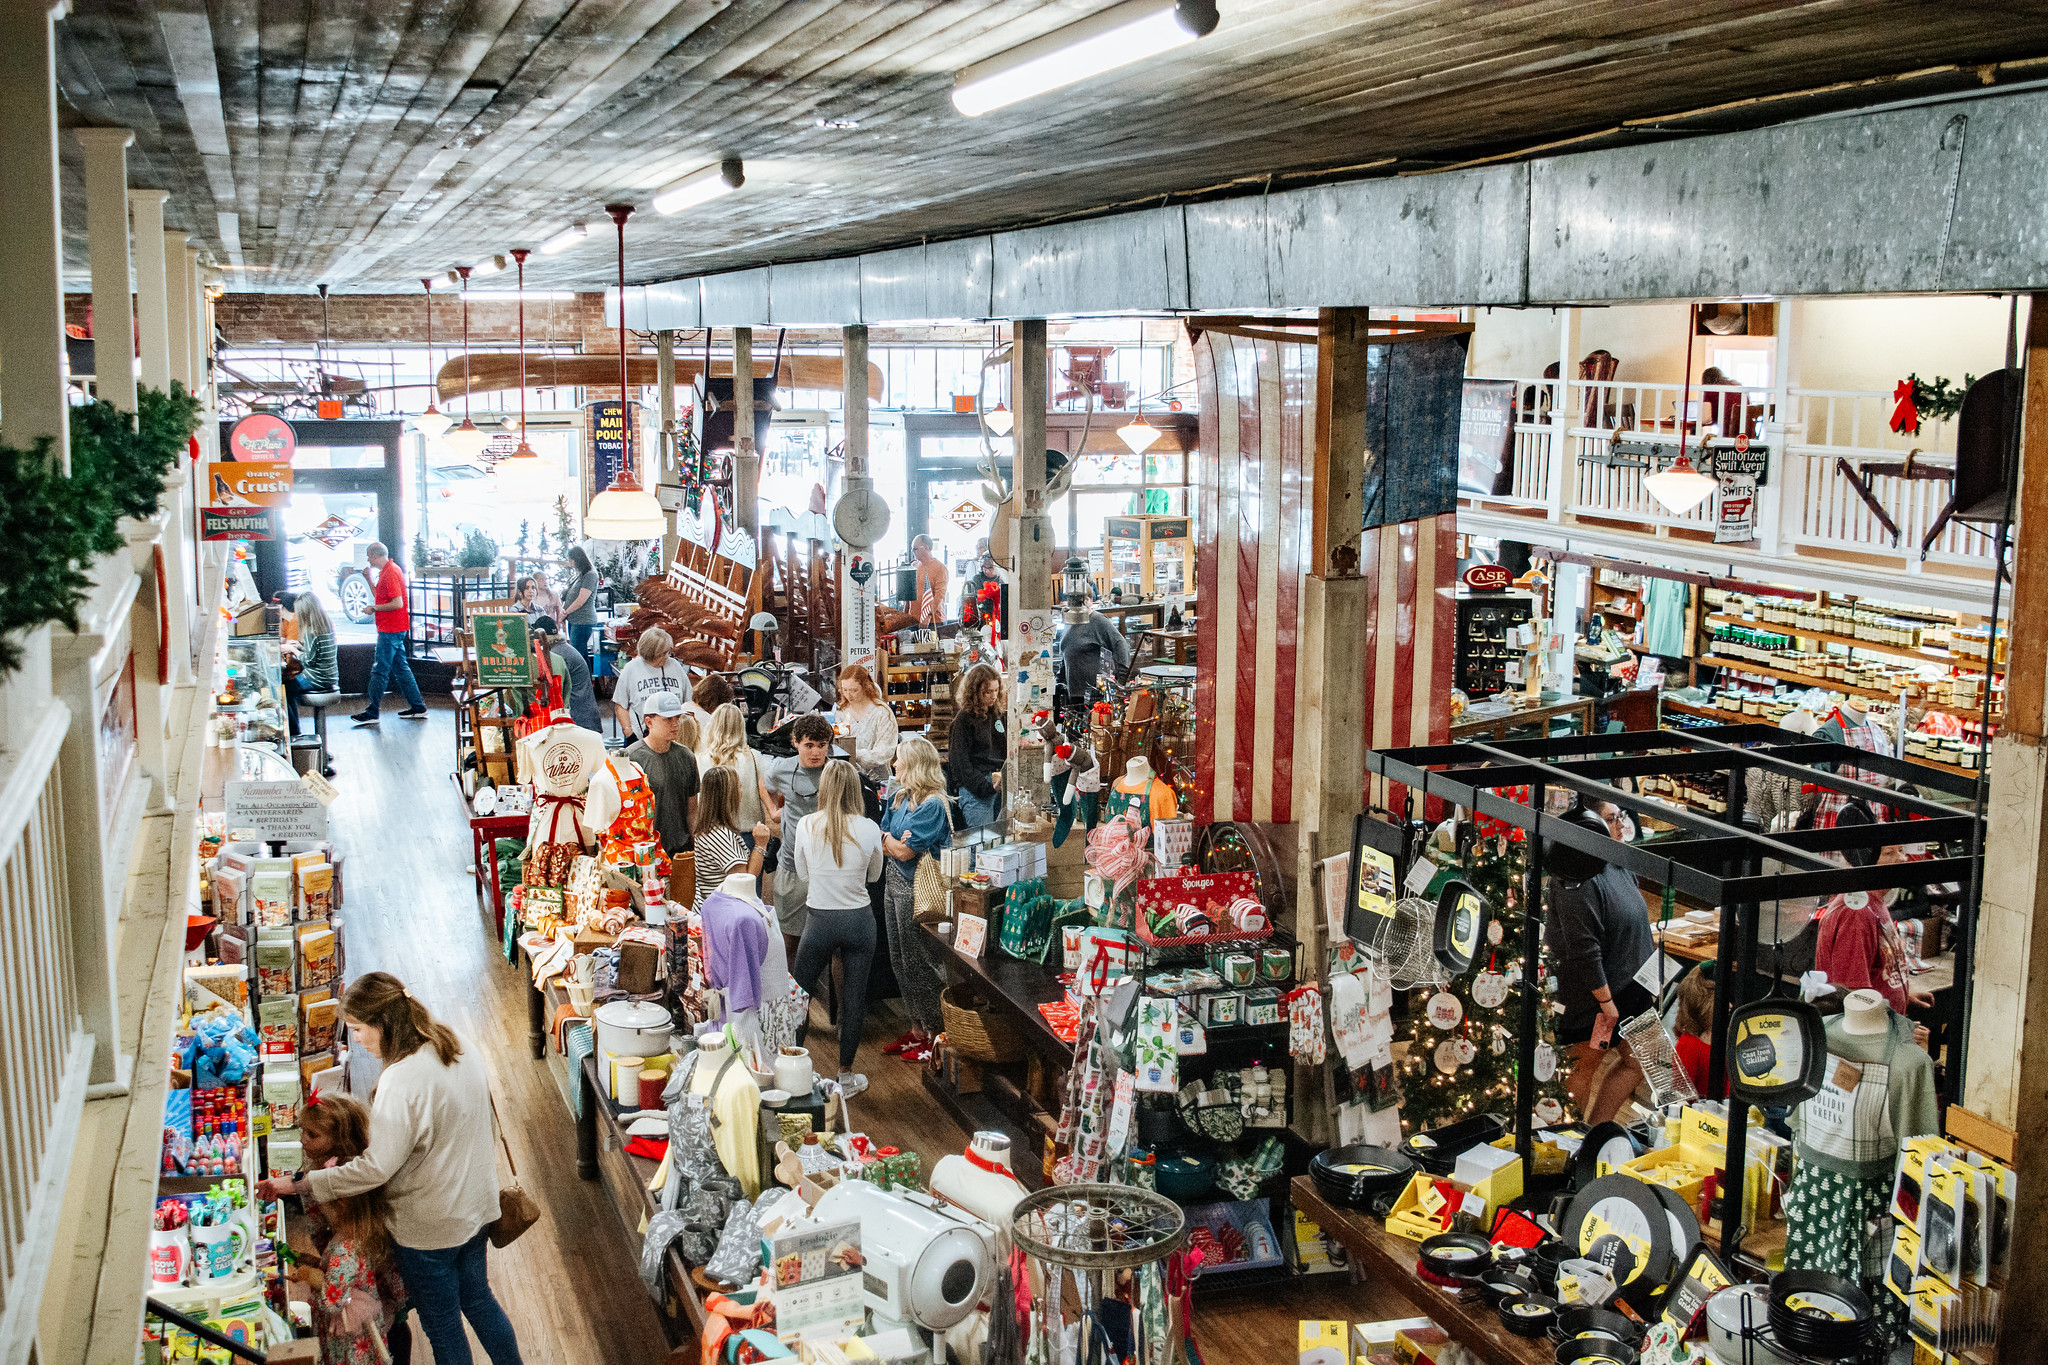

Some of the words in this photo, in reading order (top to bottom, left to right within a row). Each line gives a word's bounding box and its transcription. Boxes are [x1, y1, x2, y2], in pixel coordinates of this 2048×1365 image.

[956, 396, 974, 412] EXIT
[1472, 409, 1502, 422] STOCKING
[596, 430, 631, 440] POUCH
[1474, 424, 1500, 436] STUFFER
[1716, 450, 1766, 461] Authorized
[1715, 460, 1737, 471] Swift
[1739, 461, 1765, 472] Agent
[236, 480, 290, 494] Crush
[1722, 485, 1752, 496] SWIFT'S
[207, 518, 269, 530] FELS-NAPTHA
[1466, 568, 1507, 585] CASE
[482, 657, 524, 665] HOLIDAY
[637, 677, 660, 692] CAPE
[662, 677, 679, 688] COD
[546, 762, 579, 778] White
[243, 784, 282, 795] Remember
[1182, 878, 1214, 891] Sponges
[1759, 1019, 1781, 1029] LODGE
[1742, 1050, 1756, 1059] Cast
[1756, 1048, 1771, 1056] Iron
[1746, 1056, 1768, 1065] Skillet
[1698, 1120, 1719, 1137] LODGE
[155, 1267, 177, 1275] TALES
[1678, 1297, 1696, 1316] Griddl
